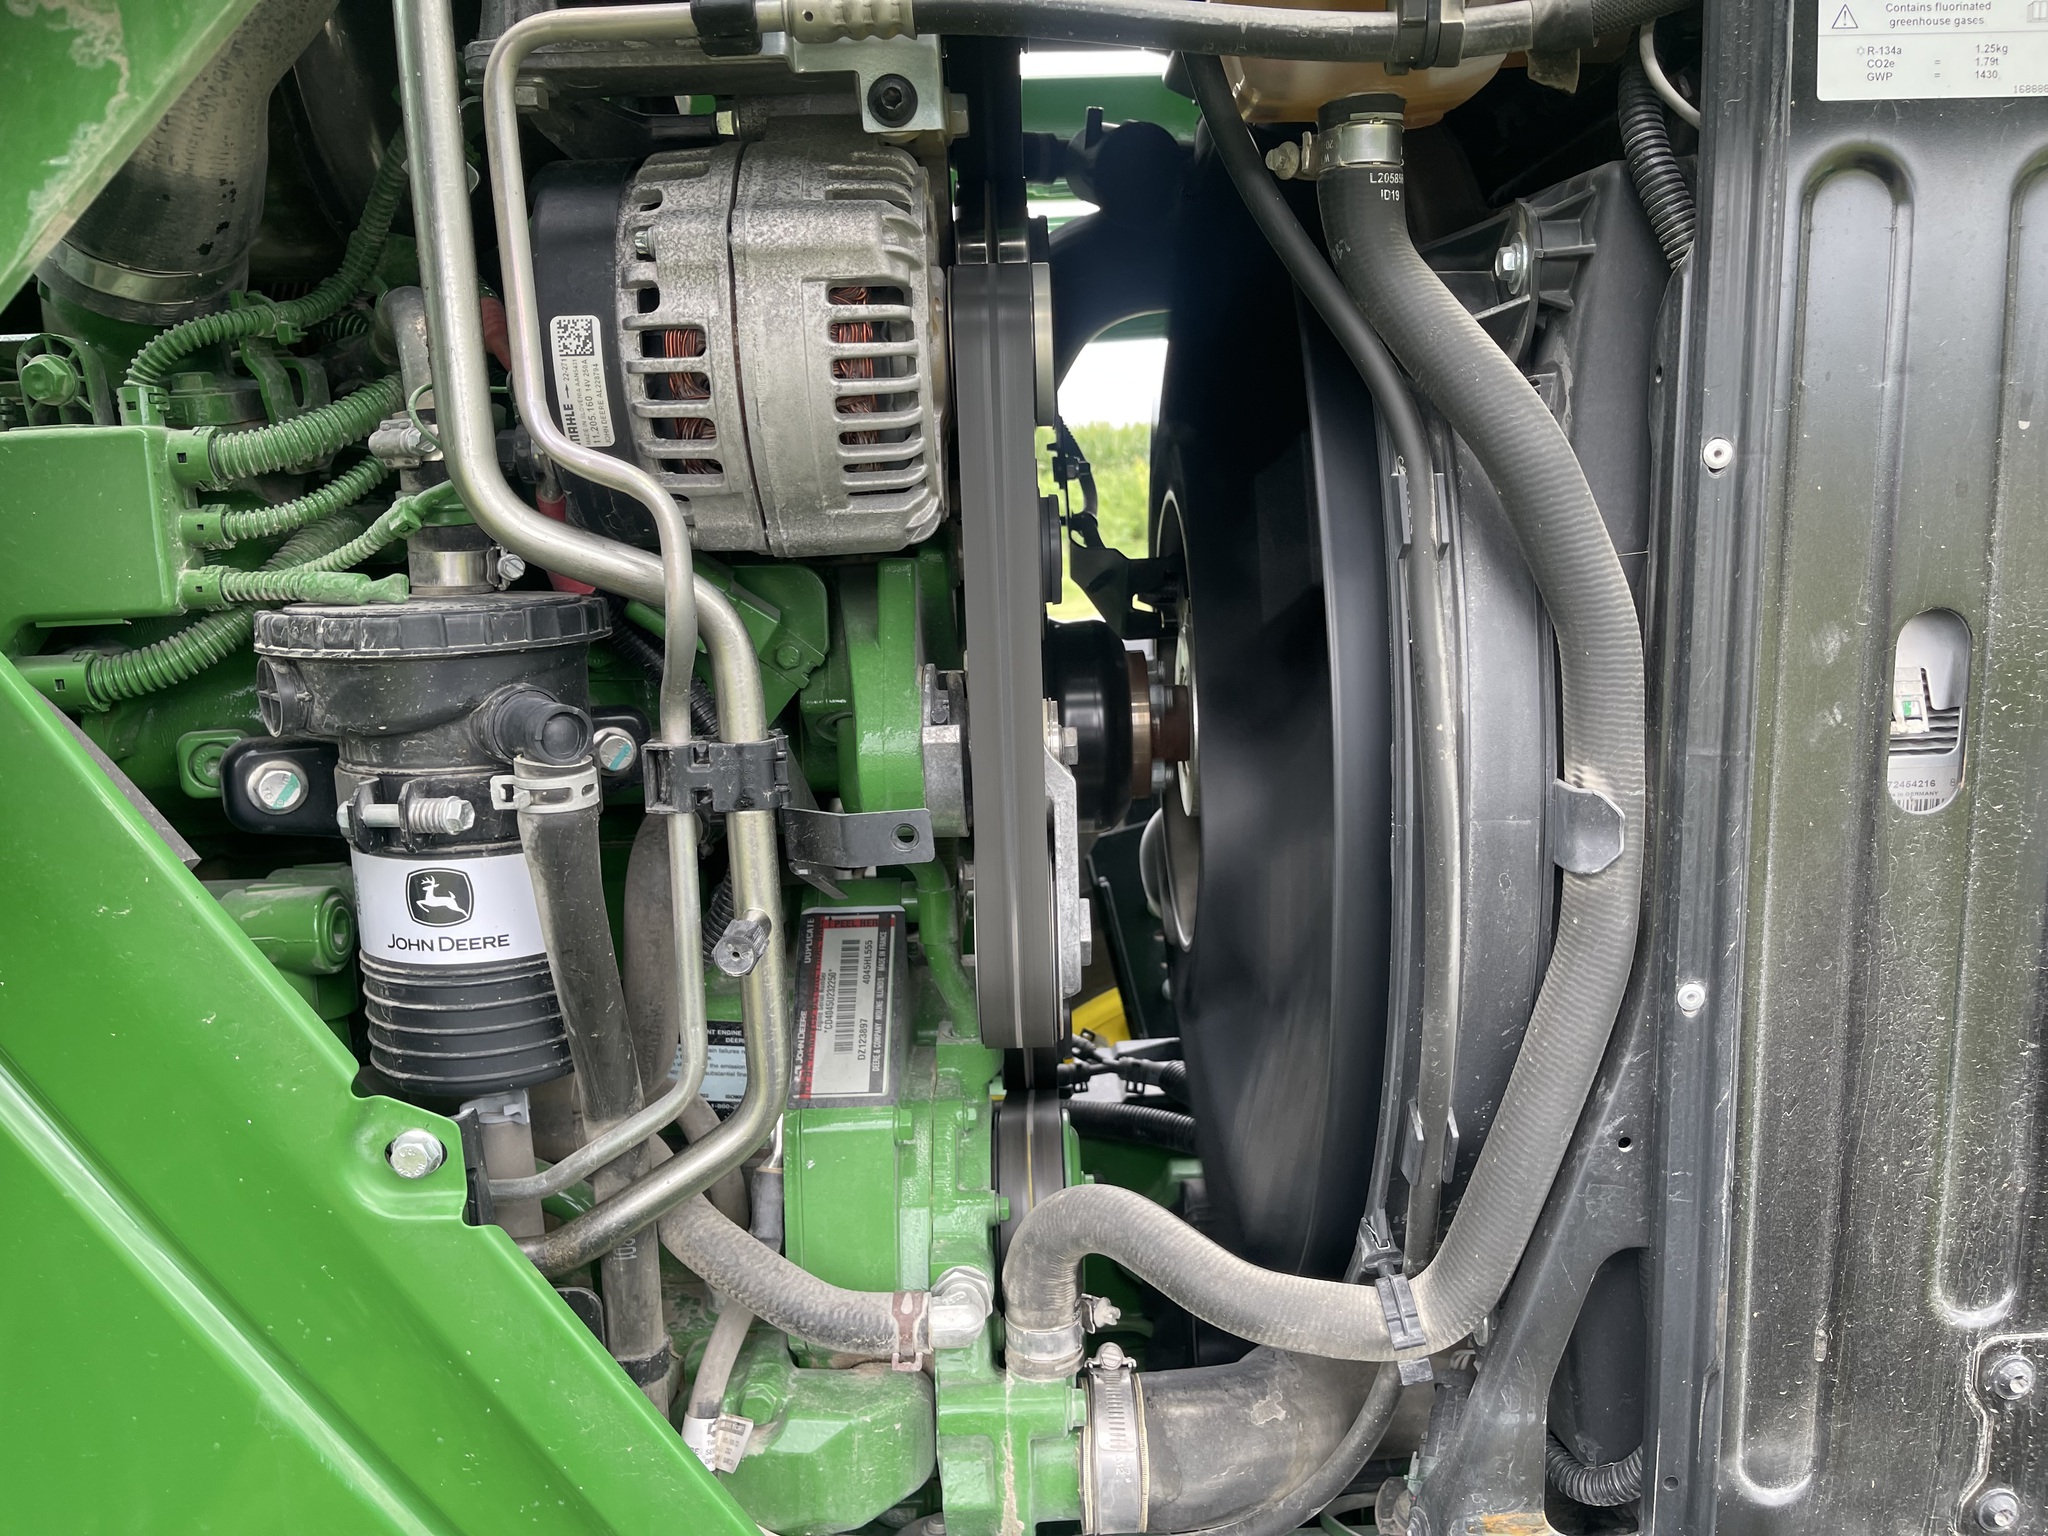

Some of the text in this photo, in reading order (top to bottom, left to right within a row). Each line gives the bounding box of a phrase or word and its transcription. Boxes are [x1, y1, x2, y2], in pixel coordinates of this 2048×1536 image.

[1886, 2, 1992, 12] Contains fluorinated
[1890, 17, 1984, 28] greenhouse gases
[1867, 44, 2008, 56] R-134a 1.25kg
[1867, 59, 1895, 68] CO2e
[1976, 58, 1999, 66] 1.79t
[1866, 72, 1893, 82] GWP
[576, 388, 586, 419] SLOVENIA
[597, 400, 607, 424] DEERE
[585, 396, 601, 444] 11.205.160
[582, 428, 591, 445] MADE
[603, 426, 611, 444] JOHN
[388, 934, 510, 952] JOHN DEERE
[804, 918, 815, 963] DUPLICATE
[879, 931, 887, 950] FRANCE
[877, 958, 886, 971] MADE
[876, 977, 885, 998] ILLINOIS
[815, 972, 826, 1031] Engine Serial Number
[857, 940, 873, 1060] DZ123897 4045HL555
[875, 1000, 884, 1020] MOLINE
[795, 1010, 808, 1063] JOHN DEERE
[873, 1023, 882, 1048] COMPANY
[872, 1054, 880, 1071] DEERE
